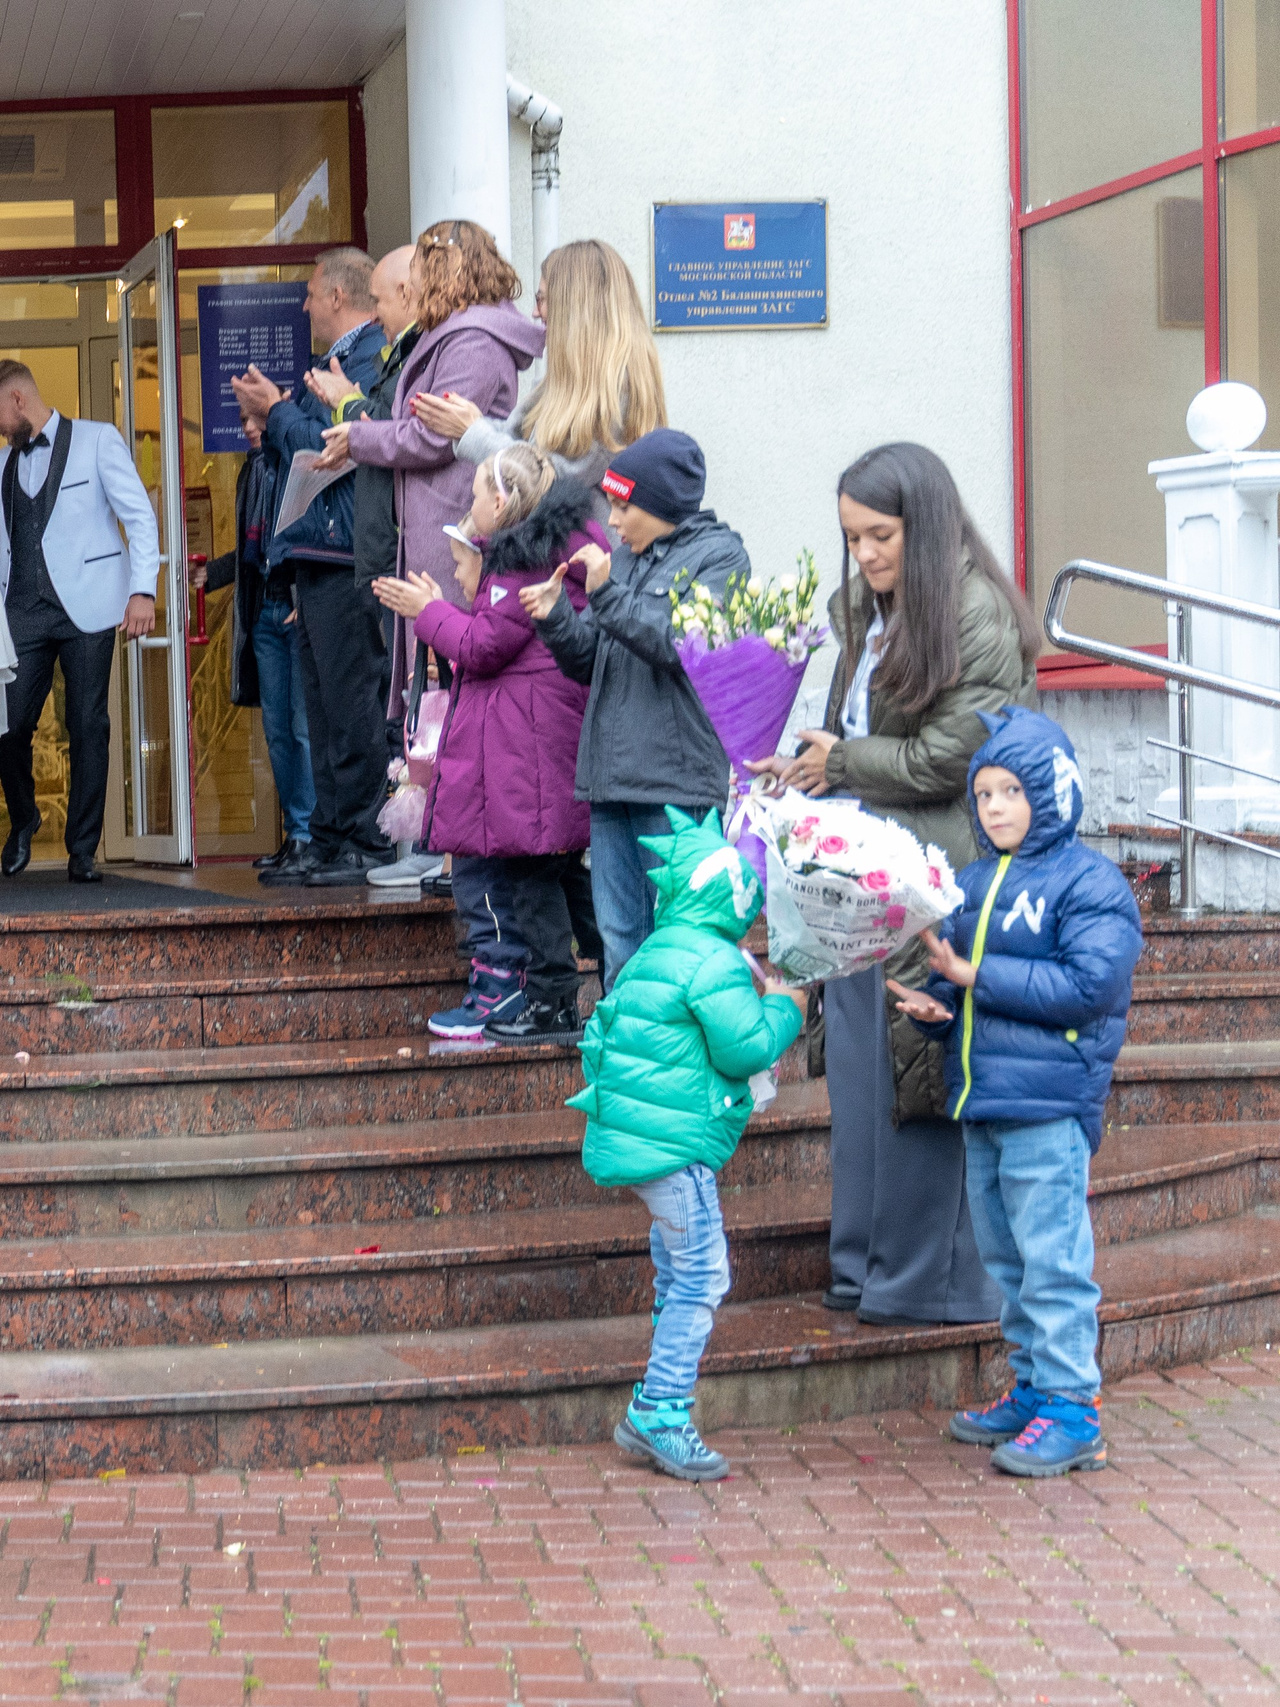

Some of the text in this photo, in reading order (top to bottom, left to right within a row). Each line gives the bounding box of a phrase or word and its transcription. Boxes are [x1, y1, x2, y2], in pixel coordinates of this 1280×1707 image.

[668, 259, 813, 272] ГЛАВНОЕ УПРАВЛЕНИЕ ЗАГС
[679, 269, 802, 282] МОСКОВСКОЙ ОБЛАСТИ
[658, 288, 824, 303] Отдел №2 Балашихинского
[686, 302, 796, 319] управления ЗАГС
[785, 877, 820, 897] PIANOS
[818, 936, 862, 951] SAINT
